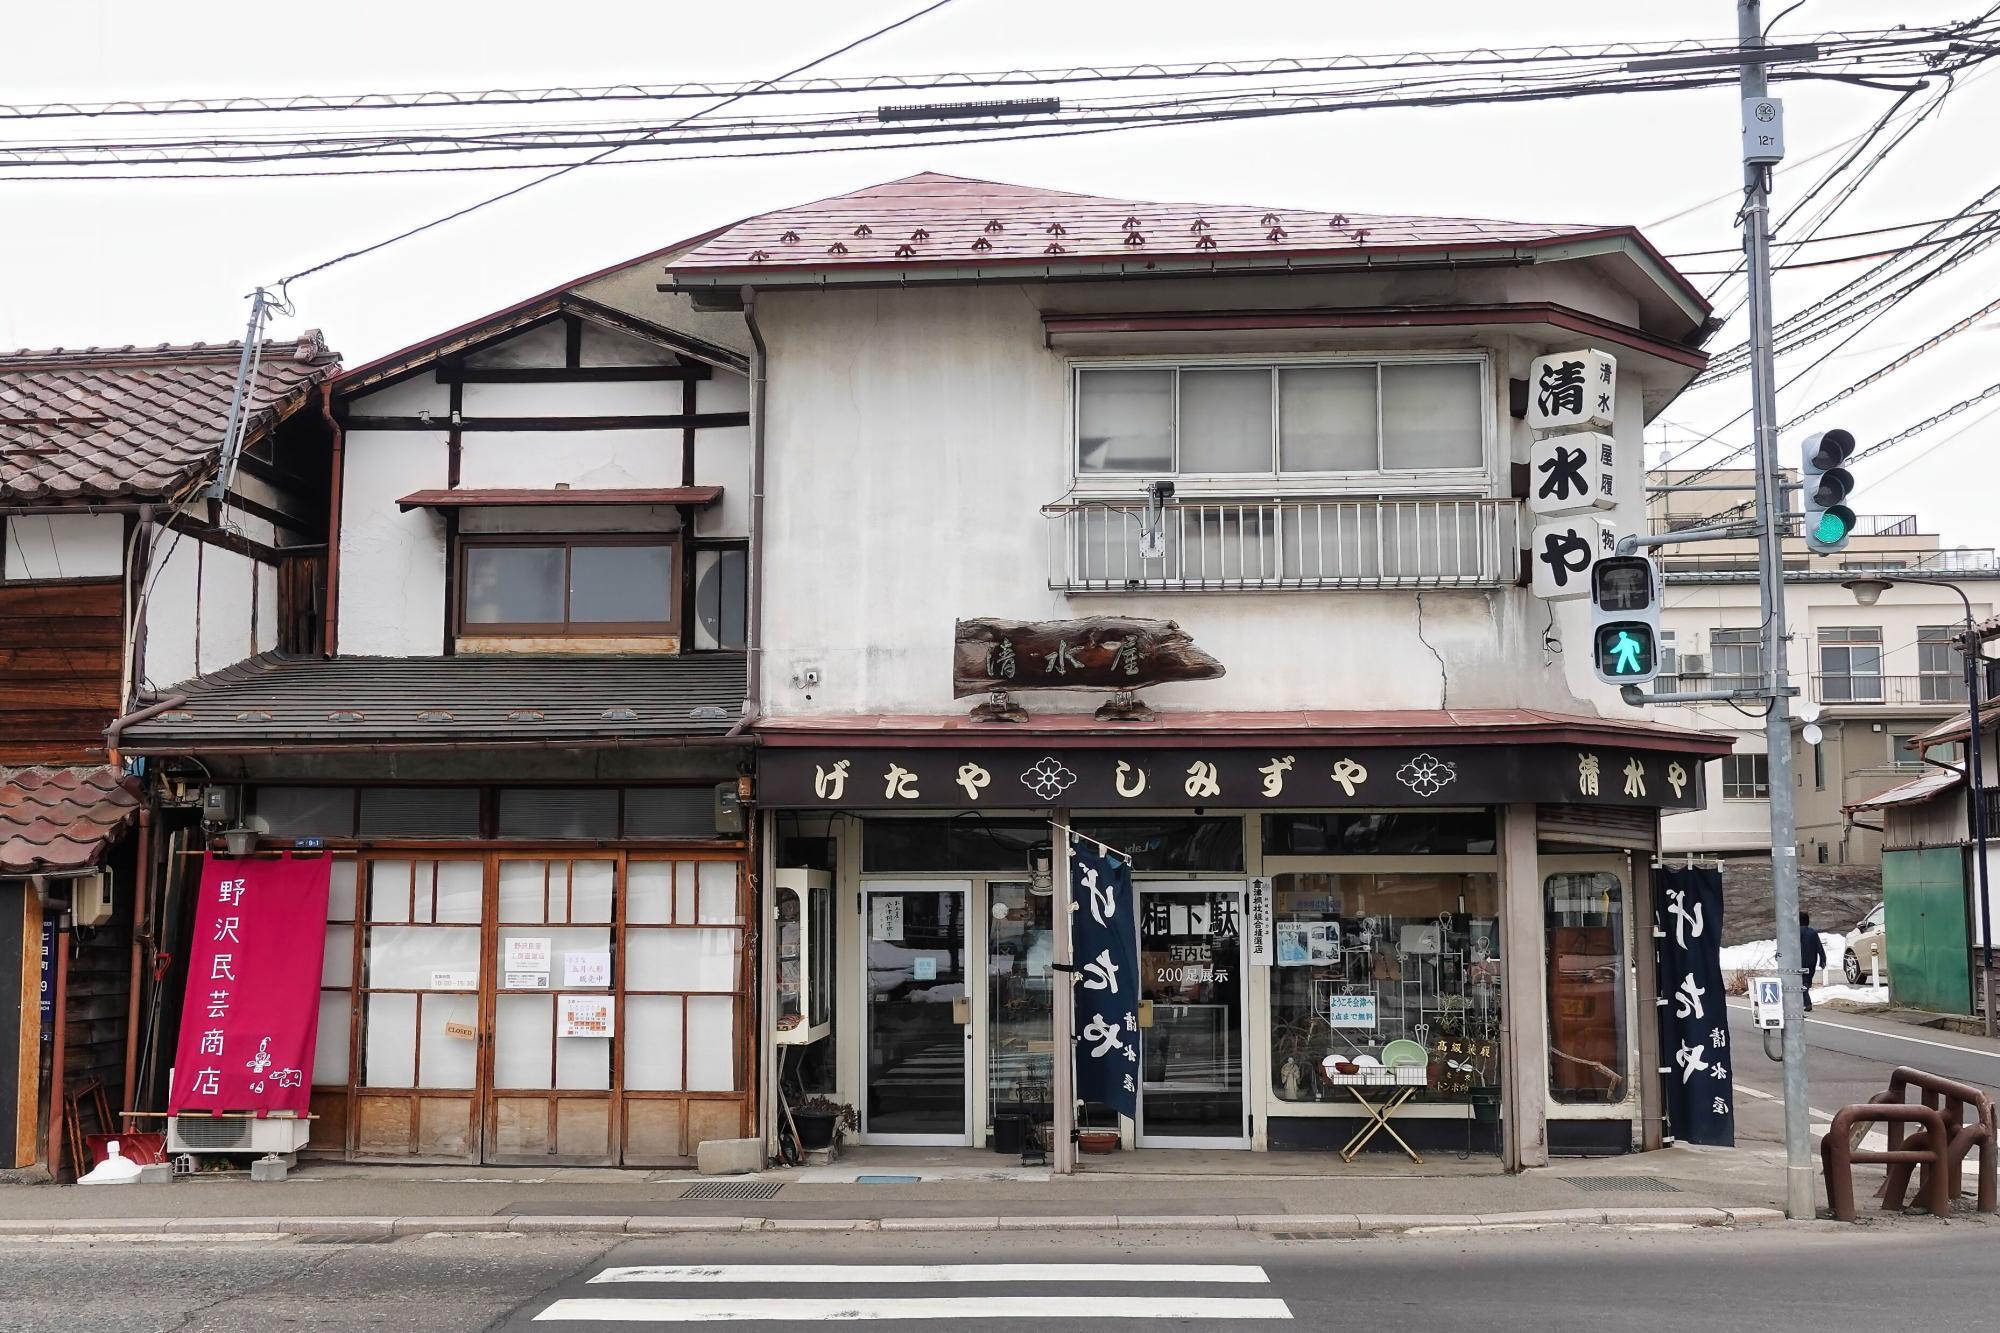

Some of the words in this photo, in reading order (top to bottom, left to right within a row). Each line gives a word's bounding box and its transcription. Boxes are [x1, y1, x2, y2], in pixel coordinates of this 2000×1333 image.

[1538, 360, 1592, 588] 清水や
[986, 634, 1144, 679] 清水屋
[815, 758, 992, 801] げたや
[1115, 755, 1368, 800] しみずや
[1578, 752, 1688, 799] 清水や
[1157, 967, 1229, 983] 200足展示
[1170, 945, 1213, 961] 店内に
[192, 878, 246, 1096] 野沢民芸商店
[1331, 997, 1375, 1008] ようこそ会津へ
[447, 1026, 473, 1037] CLOSED
